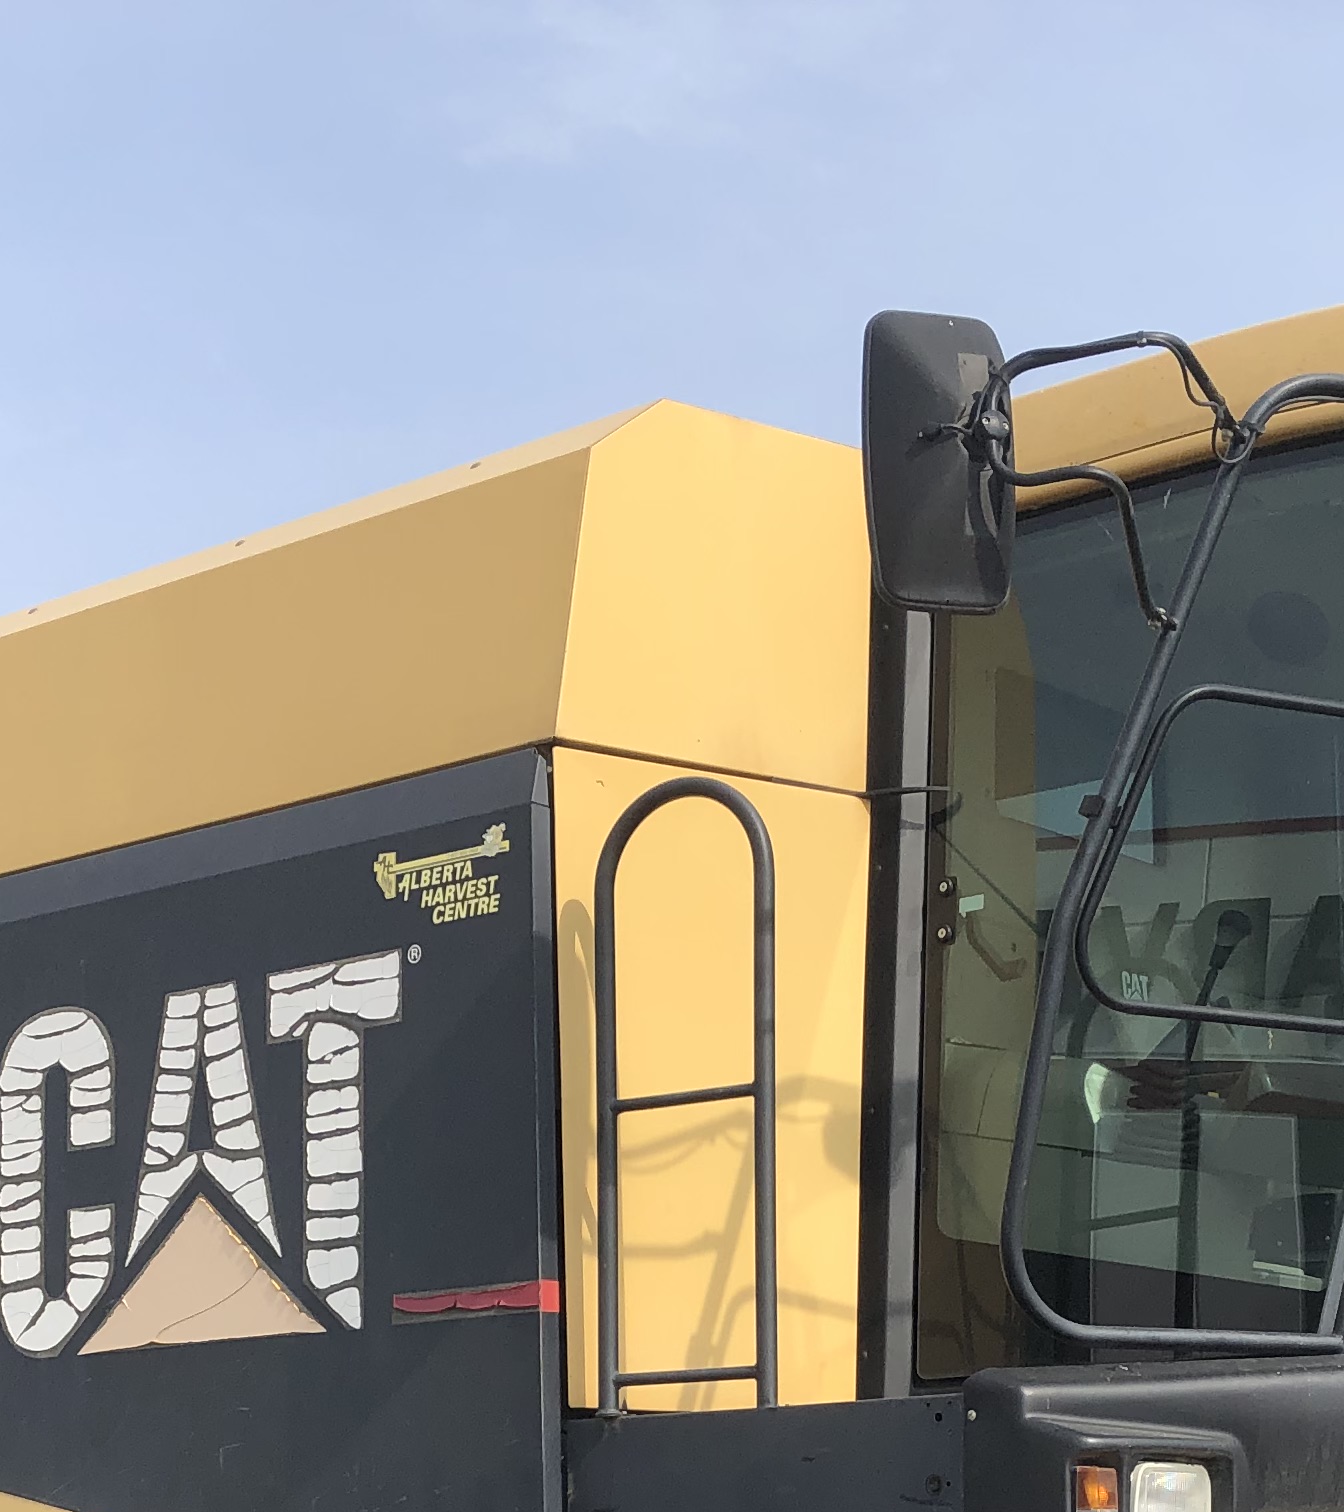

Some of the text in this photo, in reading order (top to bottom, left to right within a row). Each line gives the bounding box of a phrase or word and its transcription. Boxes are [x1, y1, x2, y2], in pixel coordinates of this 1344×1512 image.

[398, 860, 473, 901] ALBERTA
[421, 875, 499, 908] HARVEST
[432, 893, 501, 924] CENTRE
[1121, 970, 1149, 1001] CAT
